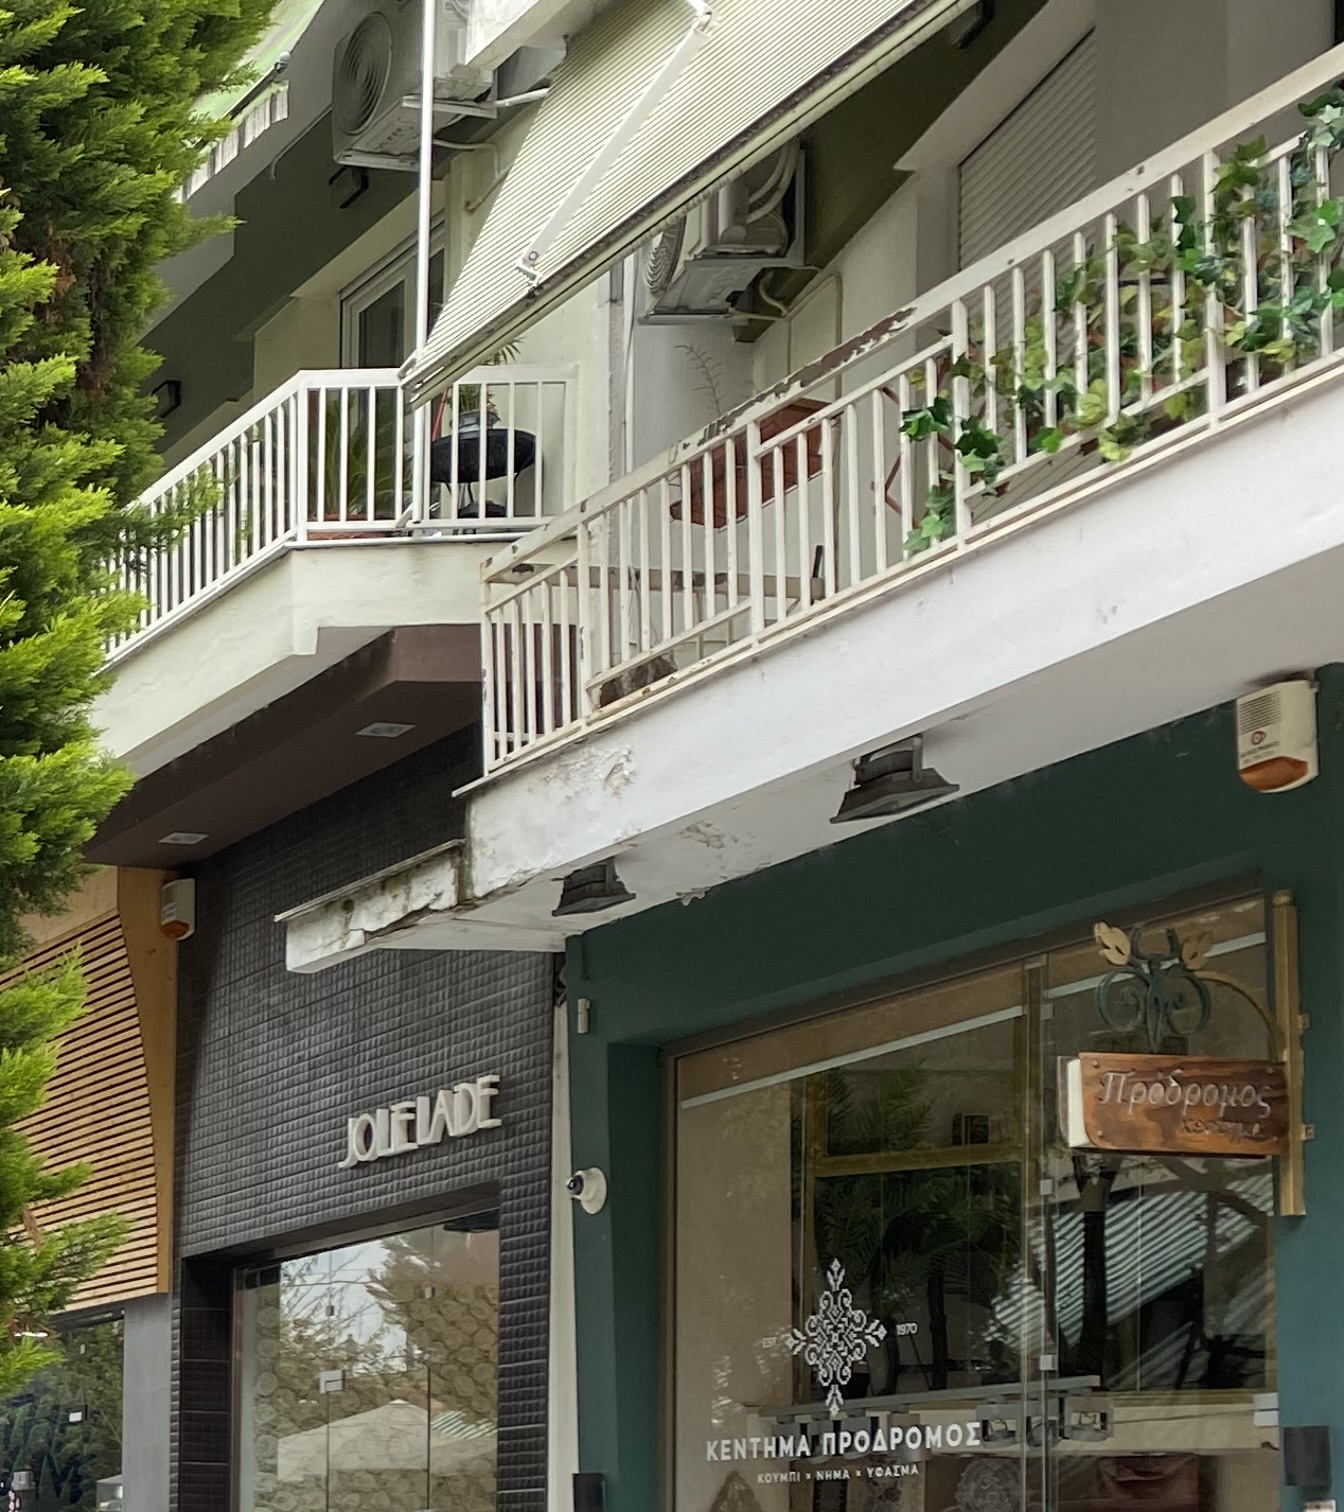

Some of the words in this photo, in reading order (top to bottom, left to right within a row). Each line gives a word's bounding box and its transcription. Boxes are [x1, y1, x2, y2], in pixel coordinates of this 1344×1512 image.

[1098, 1068, 1272, 1118] Πρόδρομος
[897, 1324, 918, 1335] 1970
[706, 1435, 811, 1461] ΚΕΝΤΗΜΑ
[822, 1422, 981, 1454] ΠΡΟΔΡΟΜΟΣ
[758, 1470, 800, 1484] ΚΟΥΜΠΙ
[816, 1470, 850, 1480] ΝΗΜΑ
